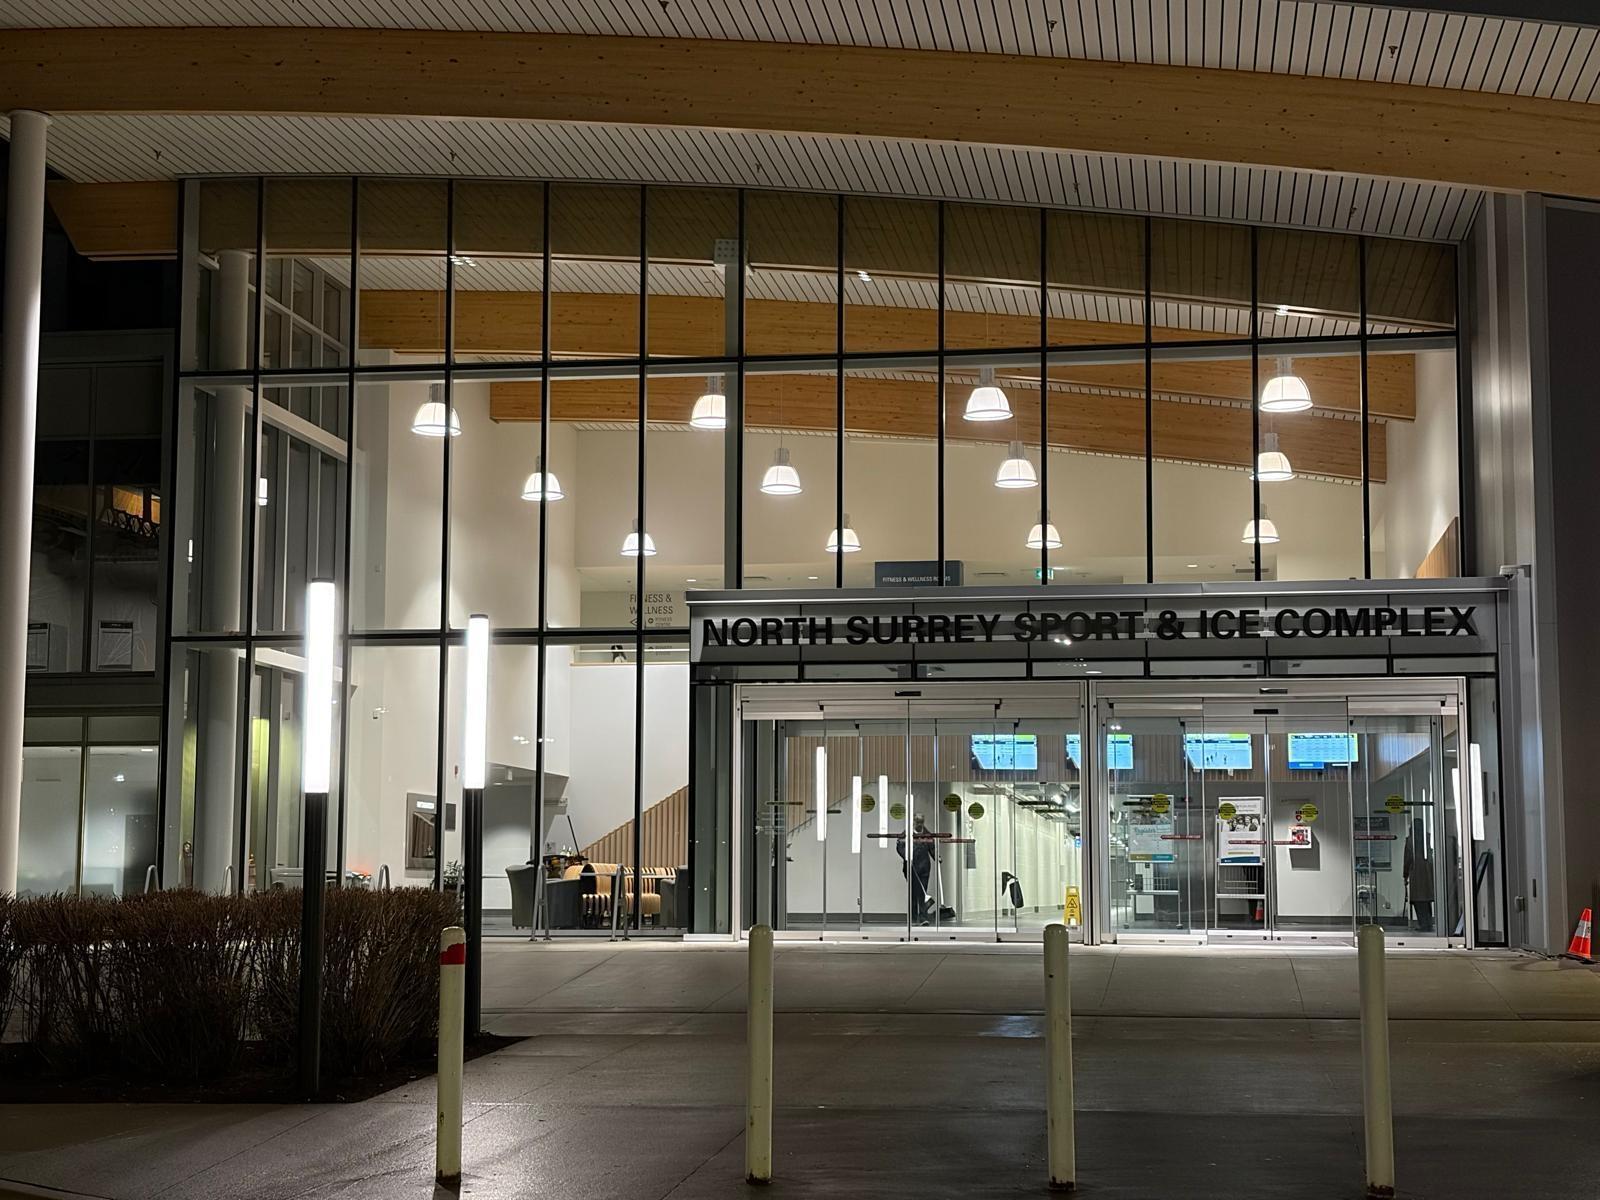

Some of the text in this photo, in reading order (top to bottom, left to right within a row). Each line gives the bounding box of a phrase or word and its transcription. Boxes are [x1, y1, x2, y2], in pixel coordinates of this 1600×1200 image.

[629, 593, 673, 603] FINESS &
[702, 606, 1479, 647] NORTH SURREY SPORT & ICE COMPLEX
